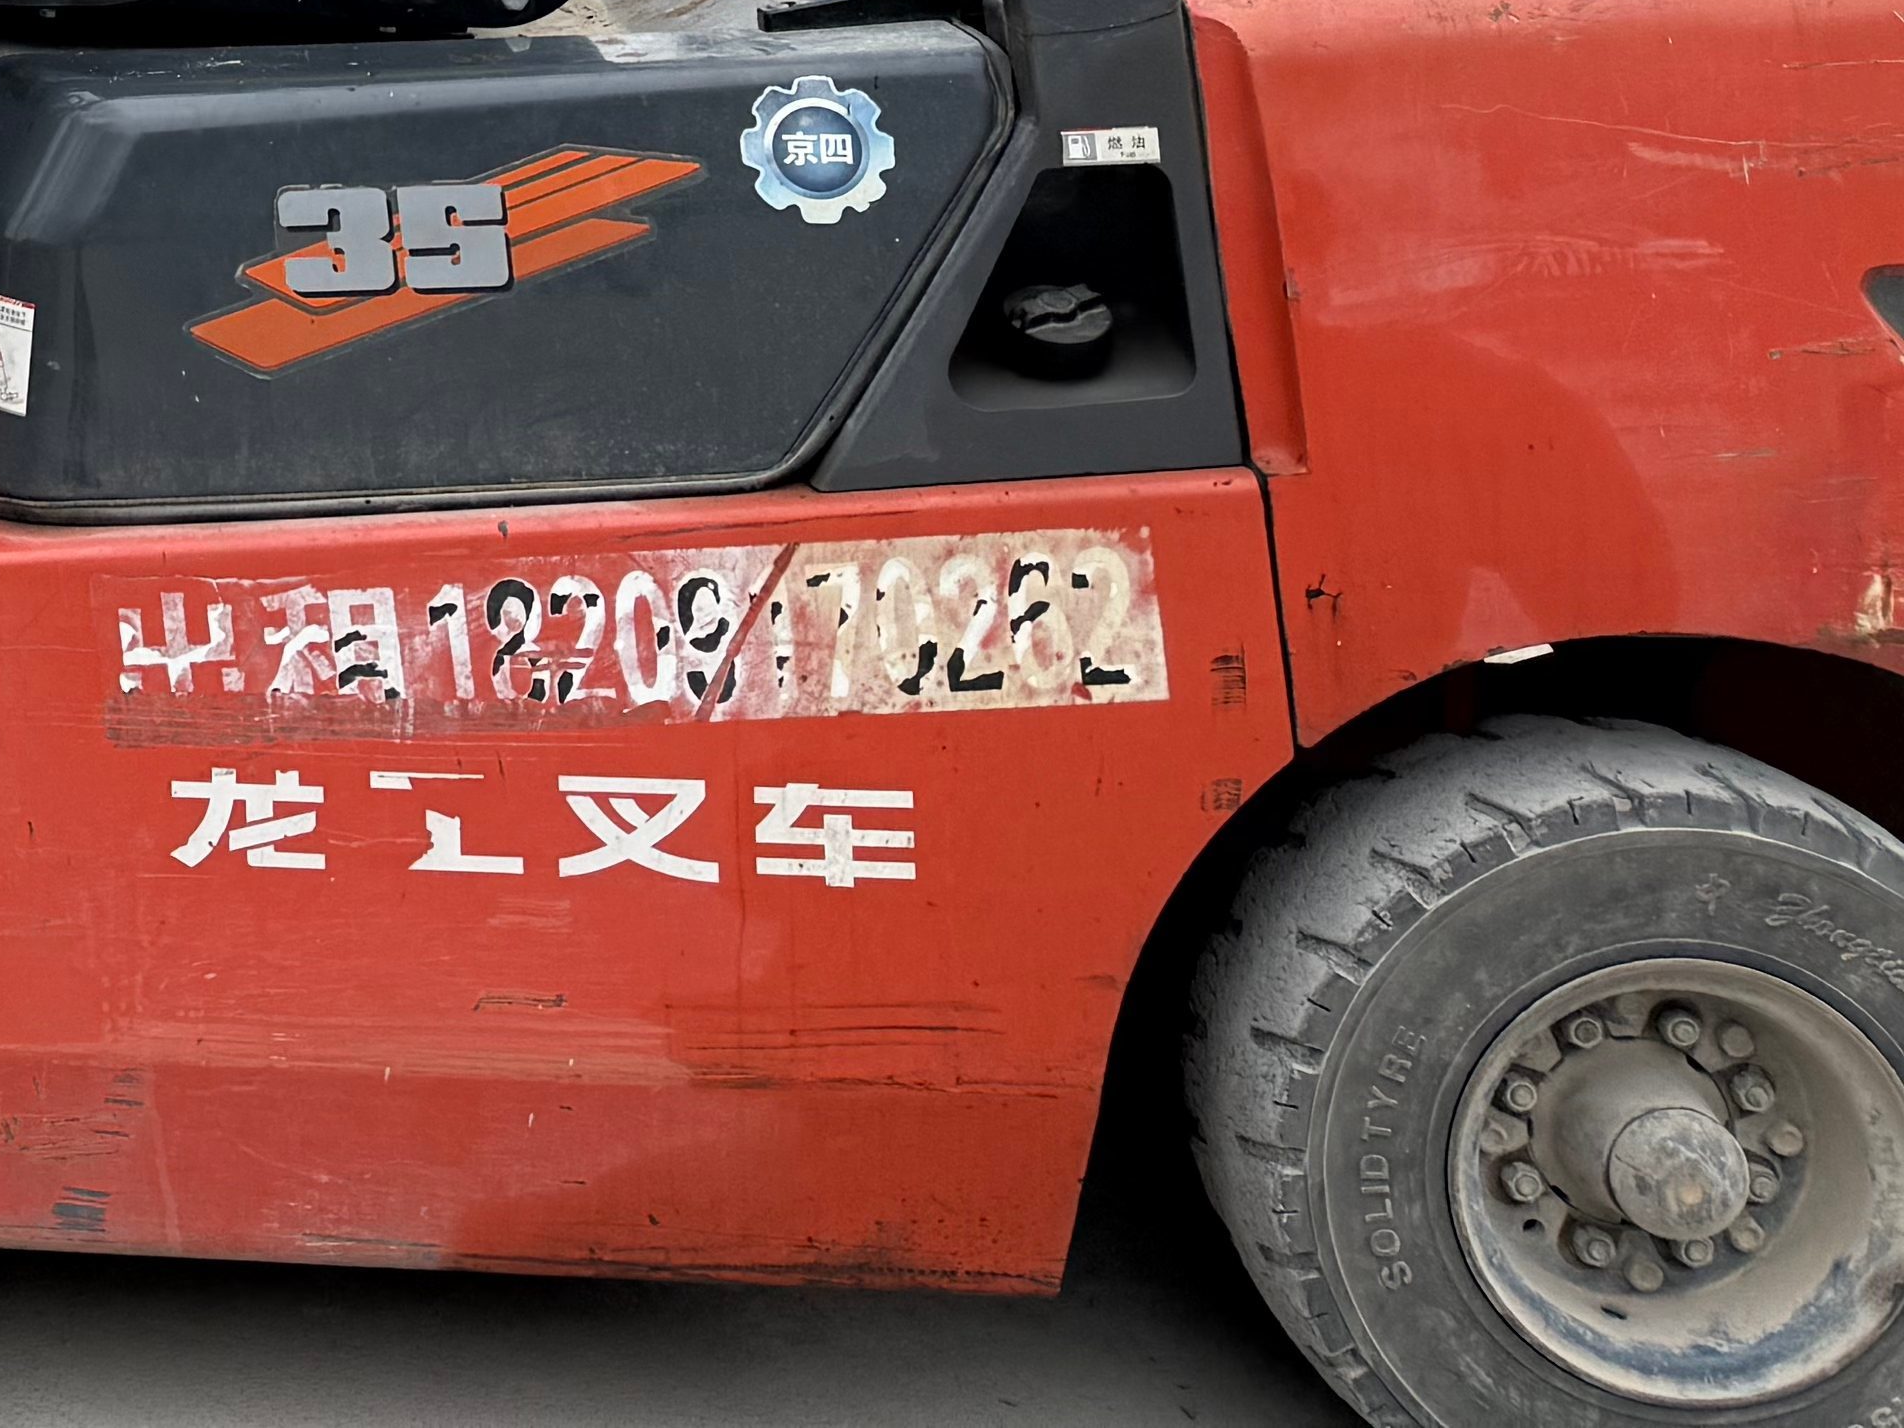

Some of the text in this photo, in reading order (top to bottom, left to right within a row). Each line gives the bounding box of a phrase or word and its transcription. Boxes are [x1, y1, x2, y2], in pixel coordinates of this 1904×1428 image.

[781, 130, 855, 166] 京四
[275, 184, 512, 298] 35
[1359, 1024, 1428, 1291] SOLID TYRE
